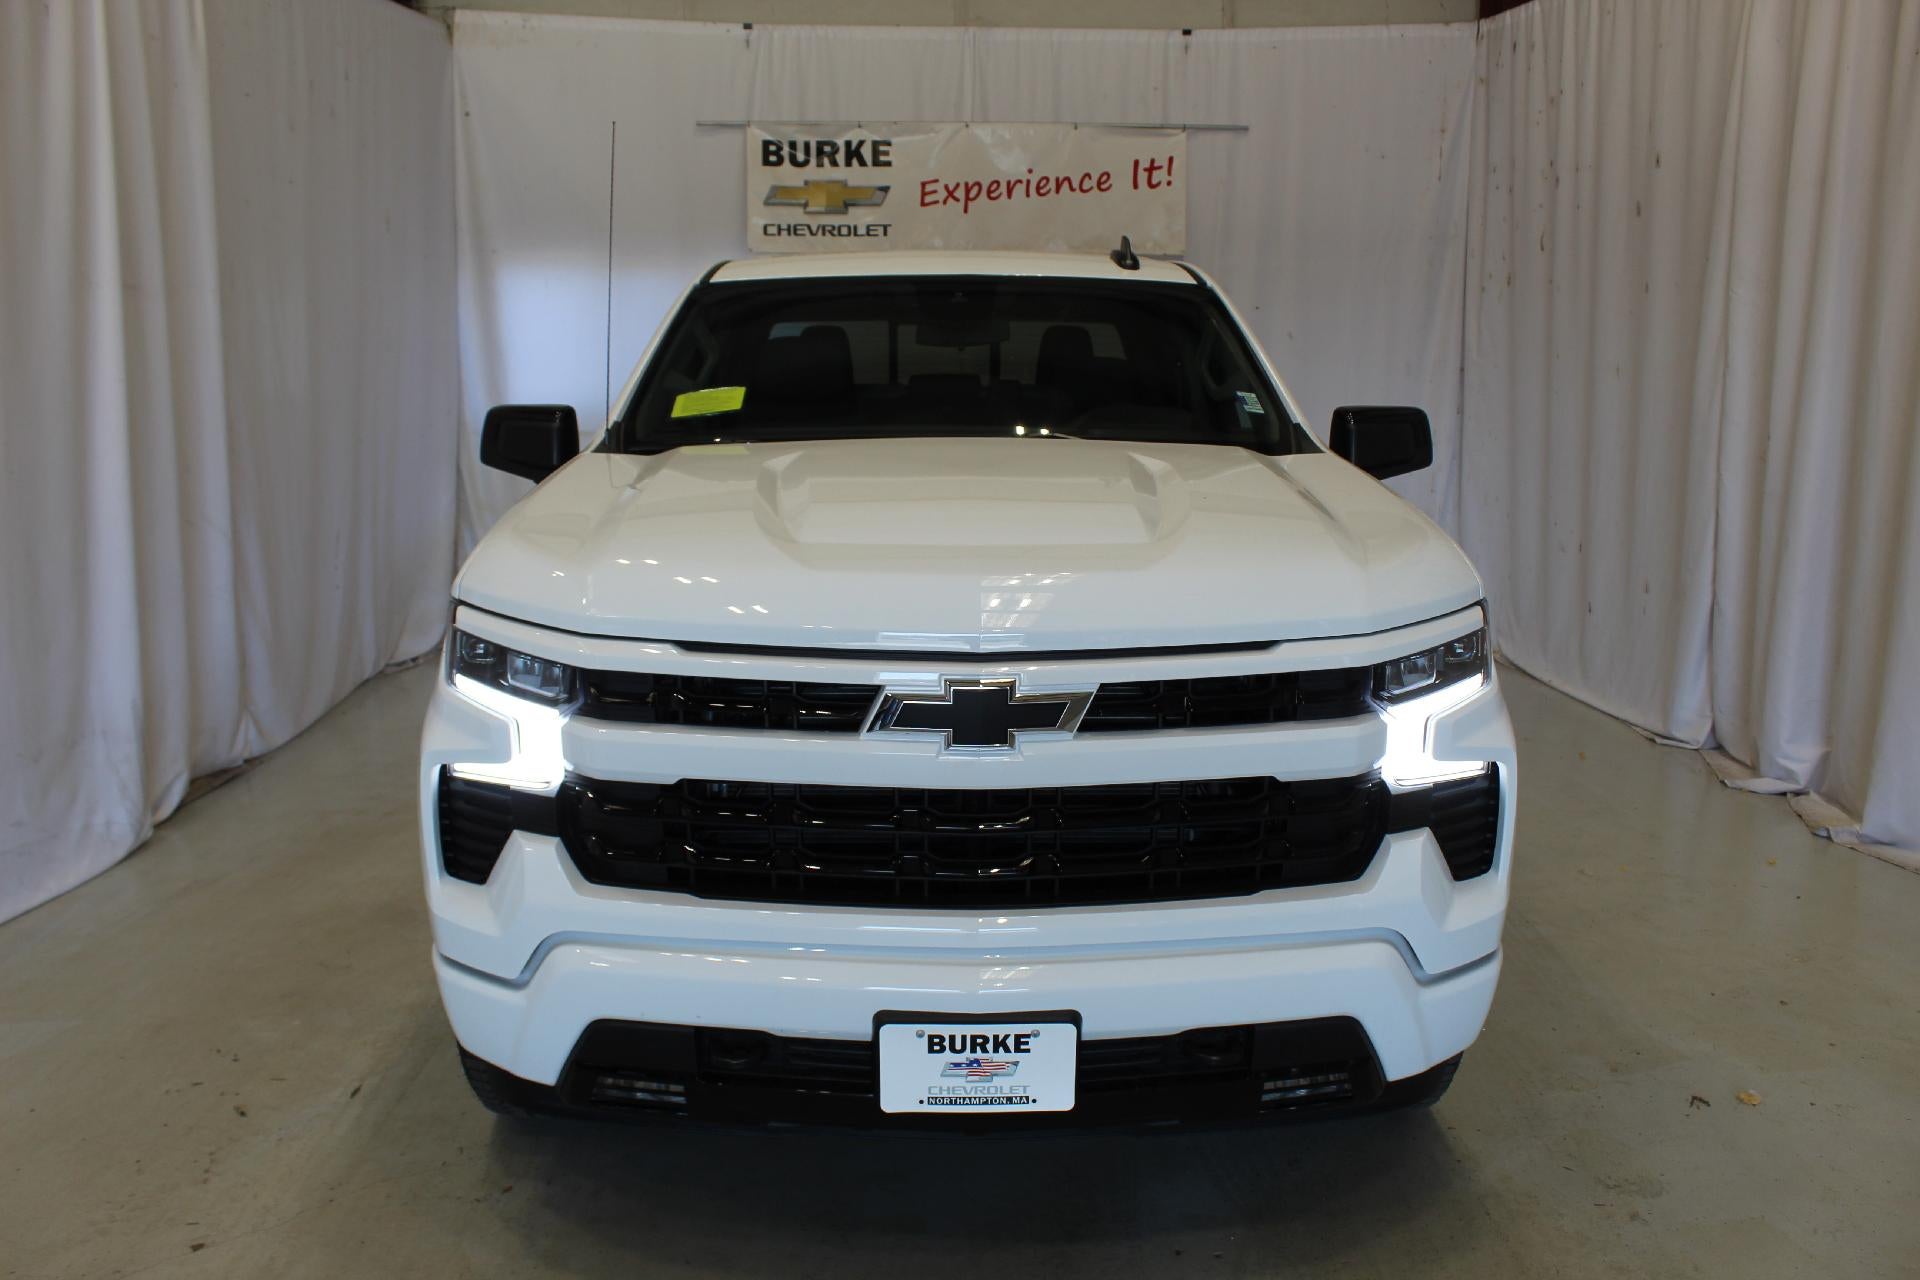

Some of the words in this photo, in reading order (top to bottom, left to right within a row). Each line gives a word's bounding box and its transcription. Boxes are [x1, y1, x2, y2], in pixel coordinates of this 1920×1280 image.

[762, 139, 893, 168] BURKE
[919, 168, 1112, 213] Experience
[1132, 156, 1174, 190] It!
[762, 223, 892, 238] CHEVROLET
[927, 1034, 1031, 1054] BURKE
[927, 1085, 1031, 1095] CHEVROLET
[928, 1096, 1010, 1105] NORTHAMPTON,
[1013, 1096, 1027, 1104] MA
